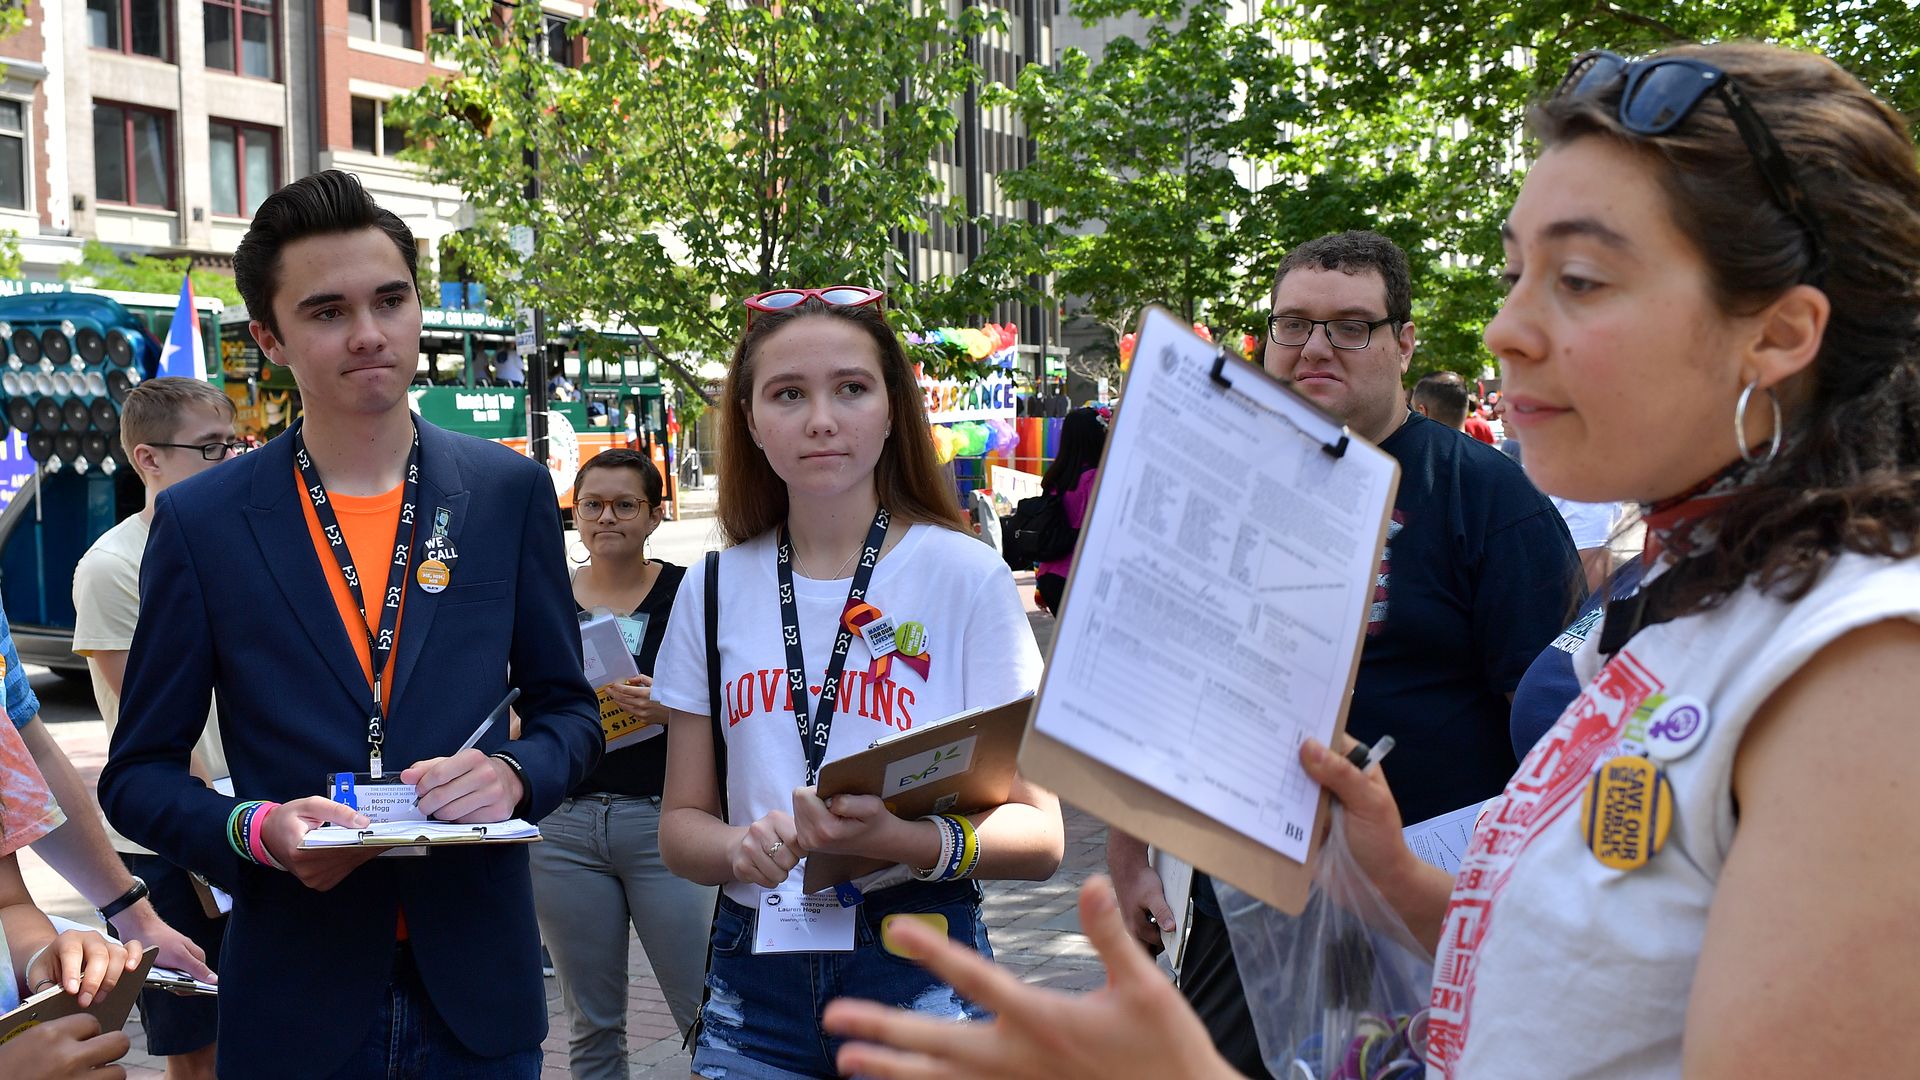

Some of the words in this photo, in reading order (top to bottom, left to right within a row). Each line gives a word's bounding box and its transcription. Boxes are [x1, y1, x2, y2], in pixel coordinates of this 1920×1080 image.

[462, 312, 485, 326] HOP
[424, 536, 445, 549] WE
[427, 547, 459, 561] CALL
[867, 622, 888, 635] MARCH
[870, 630, 882, 641] FOR
[872, 635, 888, 646] LIVES
[1626, 767, 1647, 813] SAVE
[1611, 786, 1626, 853] PUBLIC
[1284, 821, 1304, 842] BB
[1620, 819, 1641, 860] OUR
